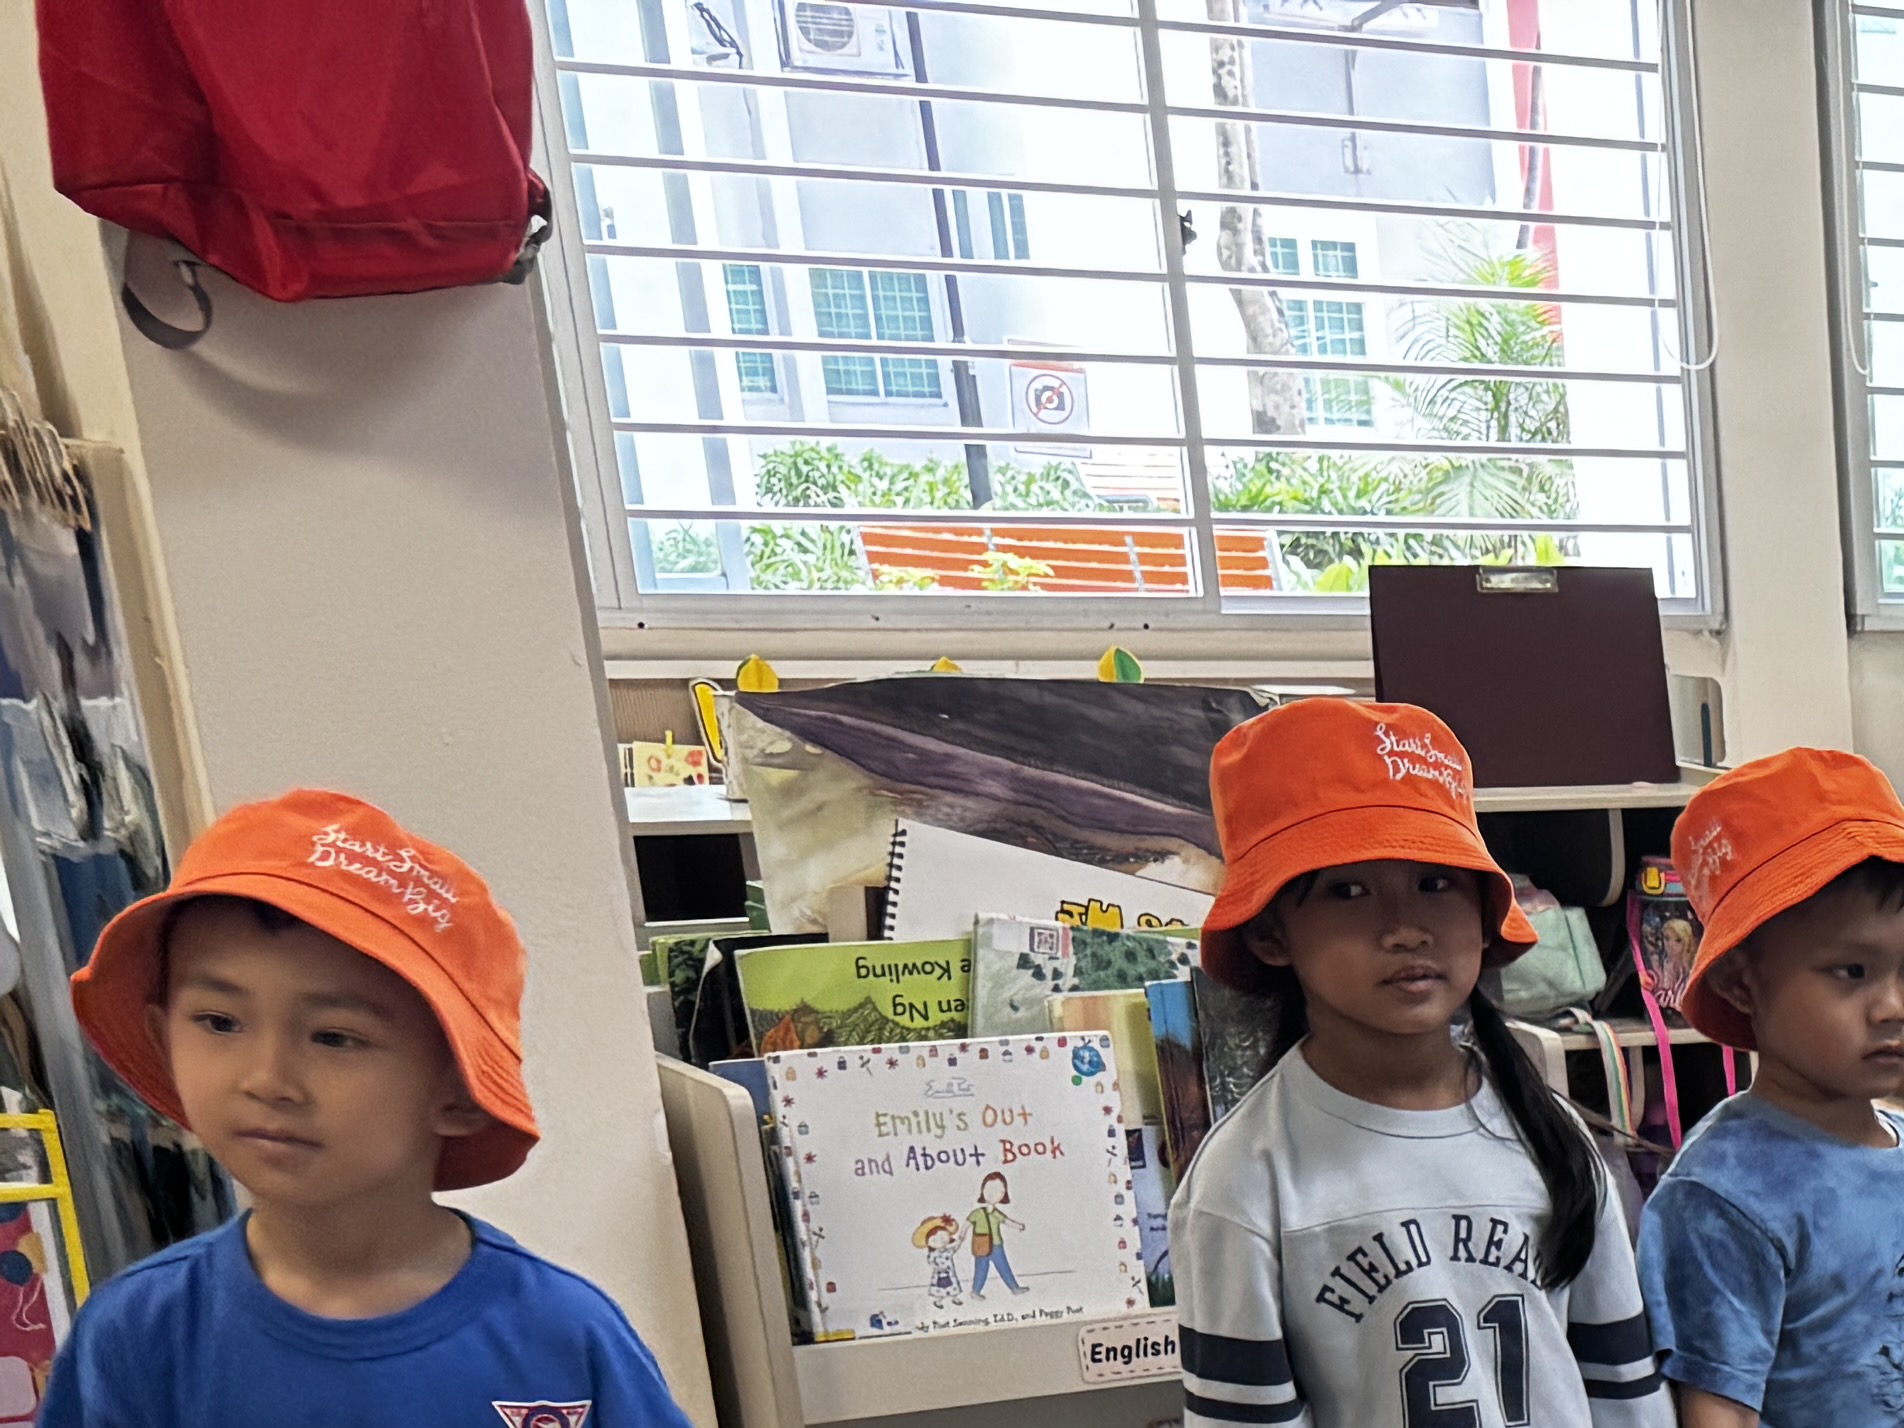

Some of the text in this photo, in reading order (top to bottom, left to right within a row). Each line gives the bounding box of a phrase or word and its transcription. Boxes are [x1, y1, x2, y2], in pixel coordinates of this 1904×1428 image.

[312, 823, 460, 904] Start Small
[306, 843, 454, 934] Dream Big
[854, 955, 953, 981] Kowling
[892, 994, 930, 1022] Ng
[874, 1103, 1033, 1139] Emily's Out
[854, 1136, 1065, 1178] and About Book
[1315, 1214, 1546, 1324] FIELD REA
[1090, 1333, 1177, 1366] English
